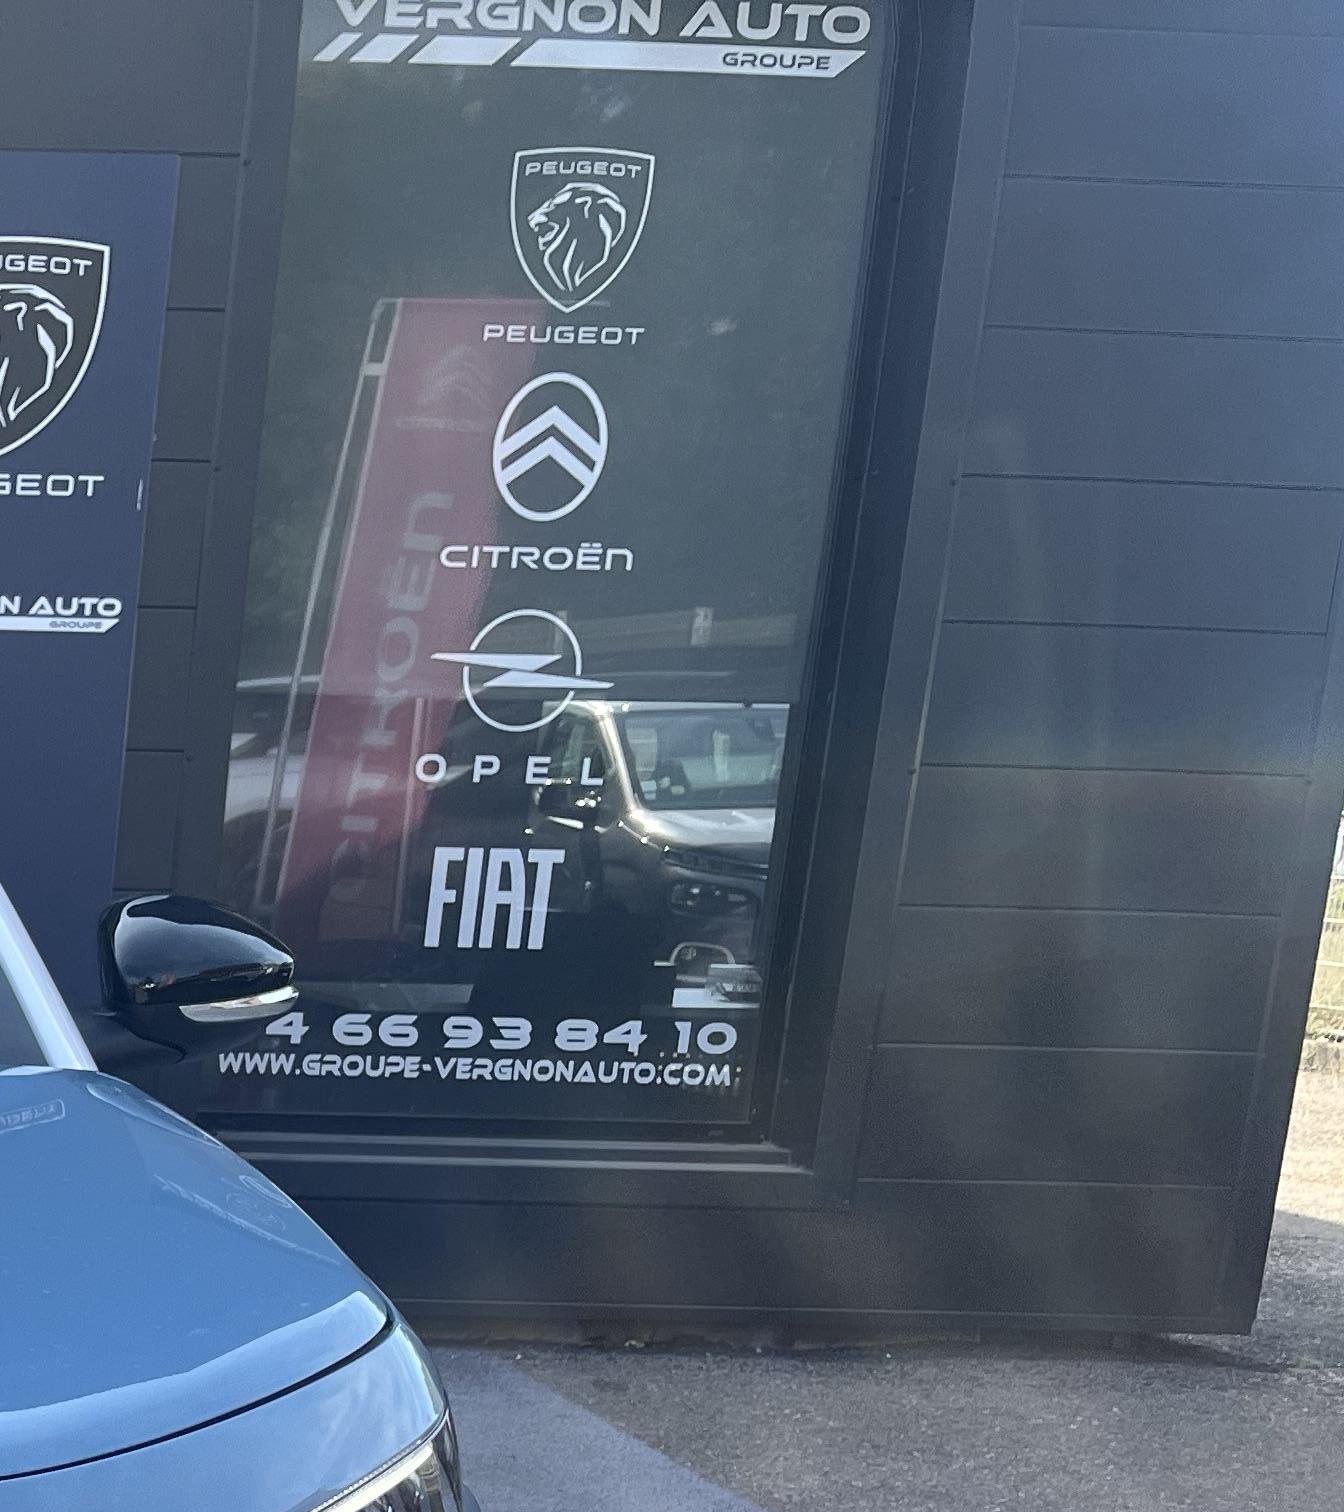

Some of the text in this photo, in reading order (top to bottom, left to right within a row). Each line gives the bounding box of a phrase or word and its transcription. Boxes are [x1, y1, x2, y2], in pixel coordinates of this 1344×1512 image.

[332, 0, 871, 43] VERGNON AUTO
[722, 52, 831, 70] GROUPE
[524, 160, 642, 179] PEUGEOT
[482, 324, 645, 346] PEUGEOT
[439, 543, 635, 572] CITROËN
[28, 595, 123, 618] AUTO
[415, 753, 604, 787] OPEL
[424, 846, 565, 951] FIAT
[332, 1013, 419, 1047] 66
[441, 1016, 532, 1050] 93
[554, 1019, 648, 1054] 84
[675, 1021, 738, 1055] 10
[218, 1051, 732, 1087] WWW.GROUPE-VERGNONAUTO.COM
